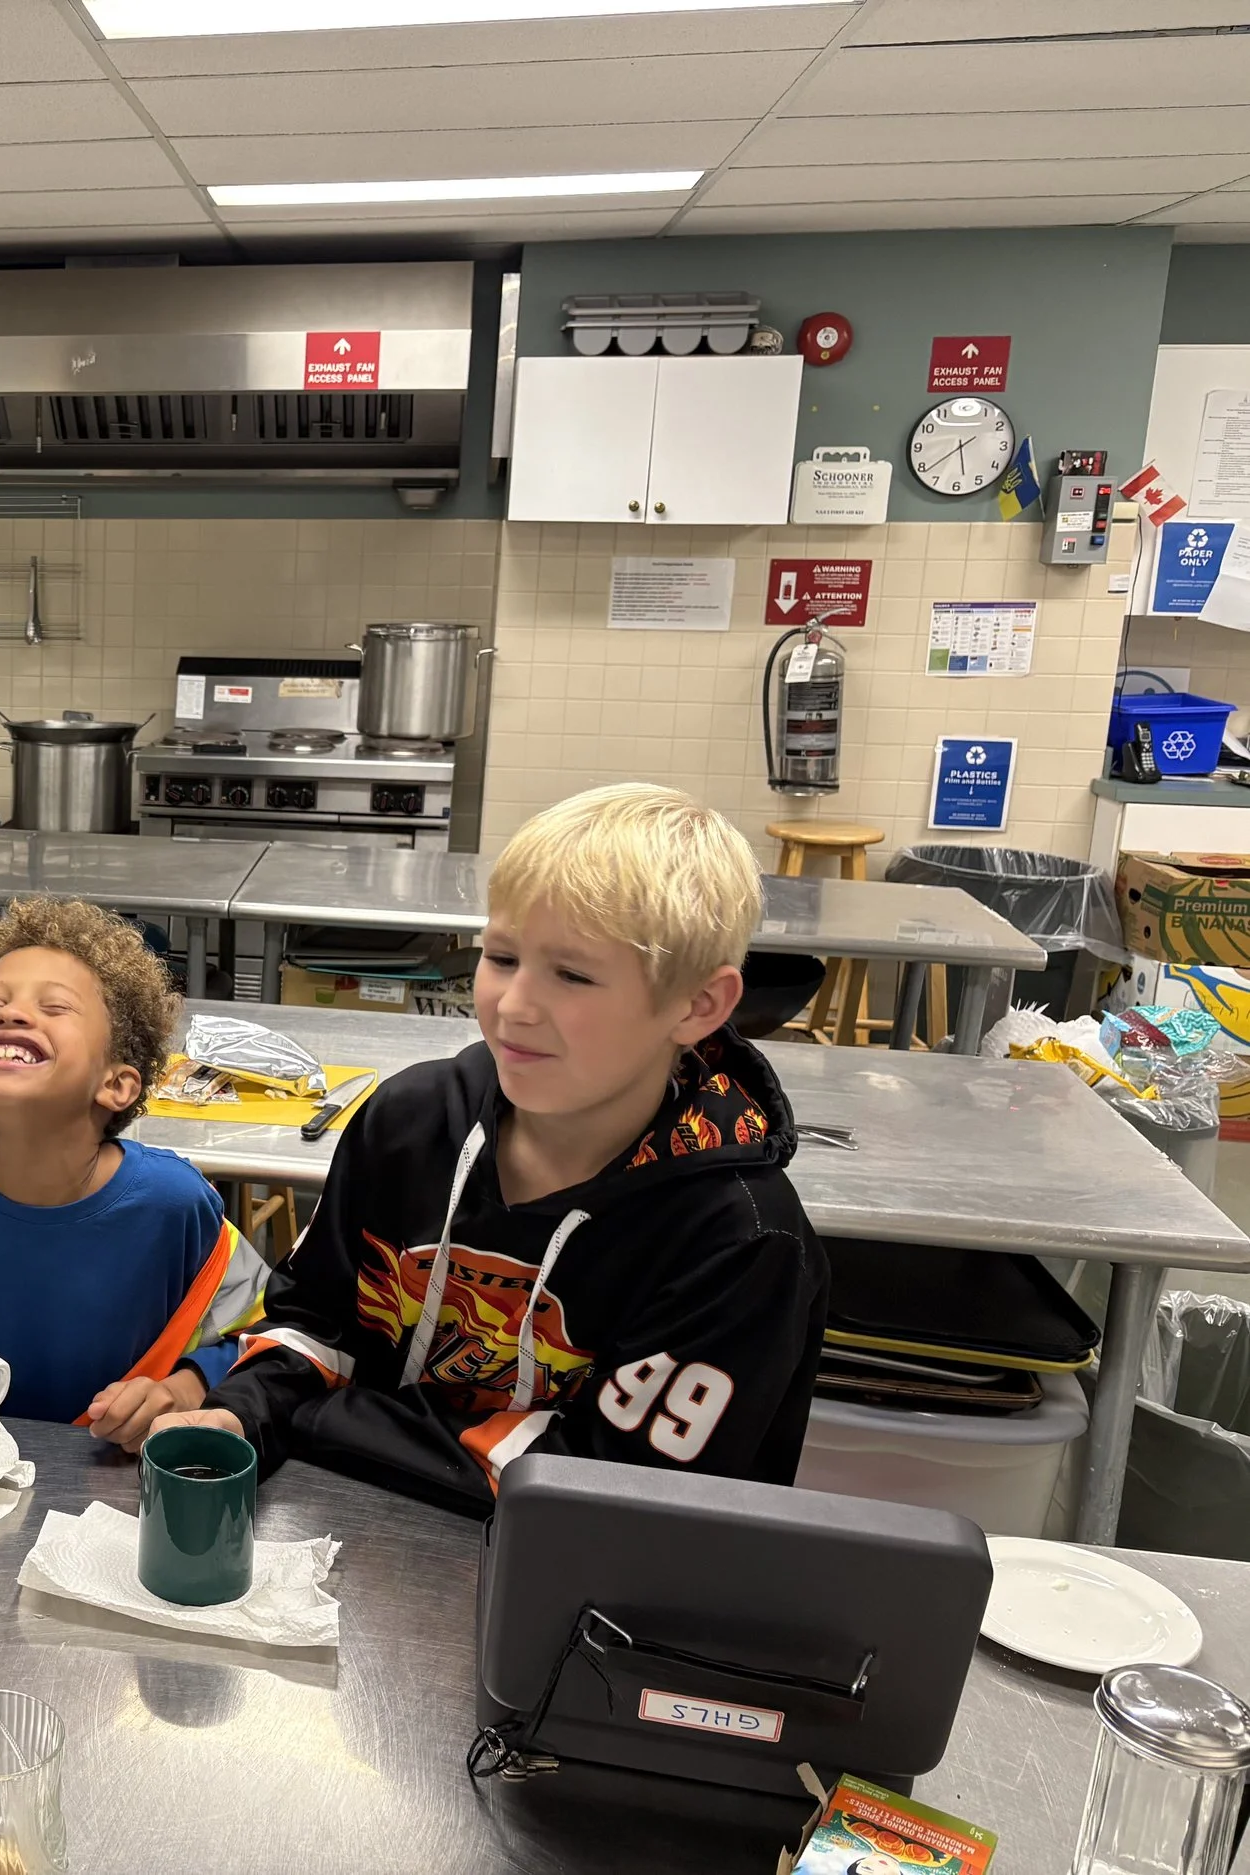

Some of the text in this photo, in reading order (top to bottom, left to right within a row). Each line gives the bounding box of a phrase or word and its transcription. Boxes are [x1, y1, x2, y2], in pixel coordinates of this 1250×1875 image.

[308, 362, 375, 372] EXHAUST FAN
[934, 367, 1003, 376] EXHAUST FAN
[308, 374, 374, 383] ACCESS PANEL
[933, 377, 1001, 386] ACCESS PANEL
[937, 408, 947, 418] 11
[922, 423, 934, 434] 10
[995, 421, 1004, 431] 2
[913, 442, 922, 453] 9
[999, 441, 1008, 451] 3
[917, 462, 926, 472] 8
[991, 460, 999, 471] 4
[813, 470, 874, 482] SCHOONER
[932, 476, 940, 486] 7
[975, 475, 983, 485] 5
[952, 482, 961, 491] 6
[1178, 550, 1213, 559] PAPER
[1180, 558, 1209, 567] ONLY
[815, 592, 862, 600] ATTENTION
[950, 770, 998, 779] PLASTICS
[1174, 898, 1248, 914] Premium
[1171, 915, 1250, 933] BNANA
[677, 1123, 701, 1153] HEA
[598, 1352, 734, 1463] 99
[671, 1704, 760, 1730] GHLS
[879, 1810, 890, 1818] ET
[891, 1812, 924, 1832] ORANGE
[857, 1807, 961, 1856] MANDARIN ORANGE SPICE
[969, 1827, 984, 1841] 54 g
[924, 1828, 975, 1855] MANDARINE
